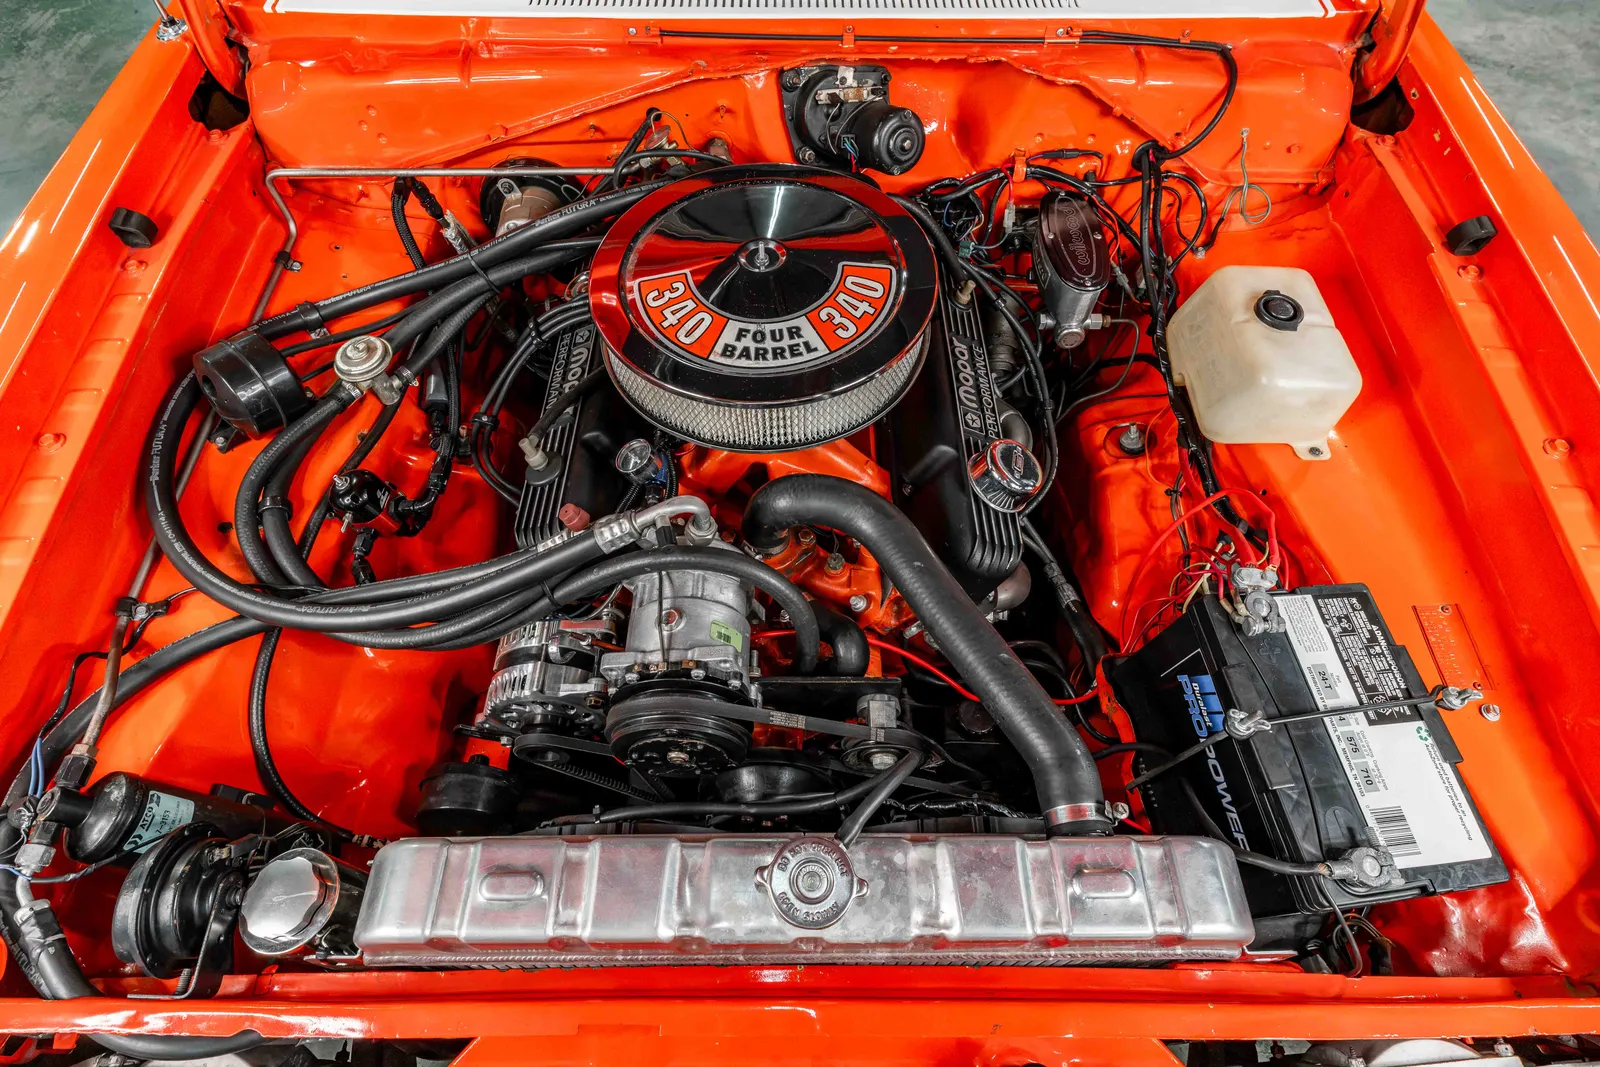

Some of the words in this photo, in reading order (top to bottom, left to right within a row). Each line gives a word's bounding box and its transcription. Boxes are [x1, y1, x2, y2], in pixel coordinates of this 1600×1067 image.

[1058, 206, 1090, 266] wilwood
[646, 280, 713, 345] 340
[818, 275, 885, 339] 340
[720, 340, 819, 361] BARREL
[734, 325, 804, 344] FOUR
[546, 333, 571, 409] PERFORMAN
[972, 344, 999, 439] PERFORMANCE
[1317, 670, 1332, 690] 24-T
[1177, 674, 1208, 738] PRO
[1192, 682, 1213, 728] Duralast
[1345, 736, 1360, 753] 575
[1360, 768, 1374, 785] 710
[139, 805, 154, 829] ATCO
